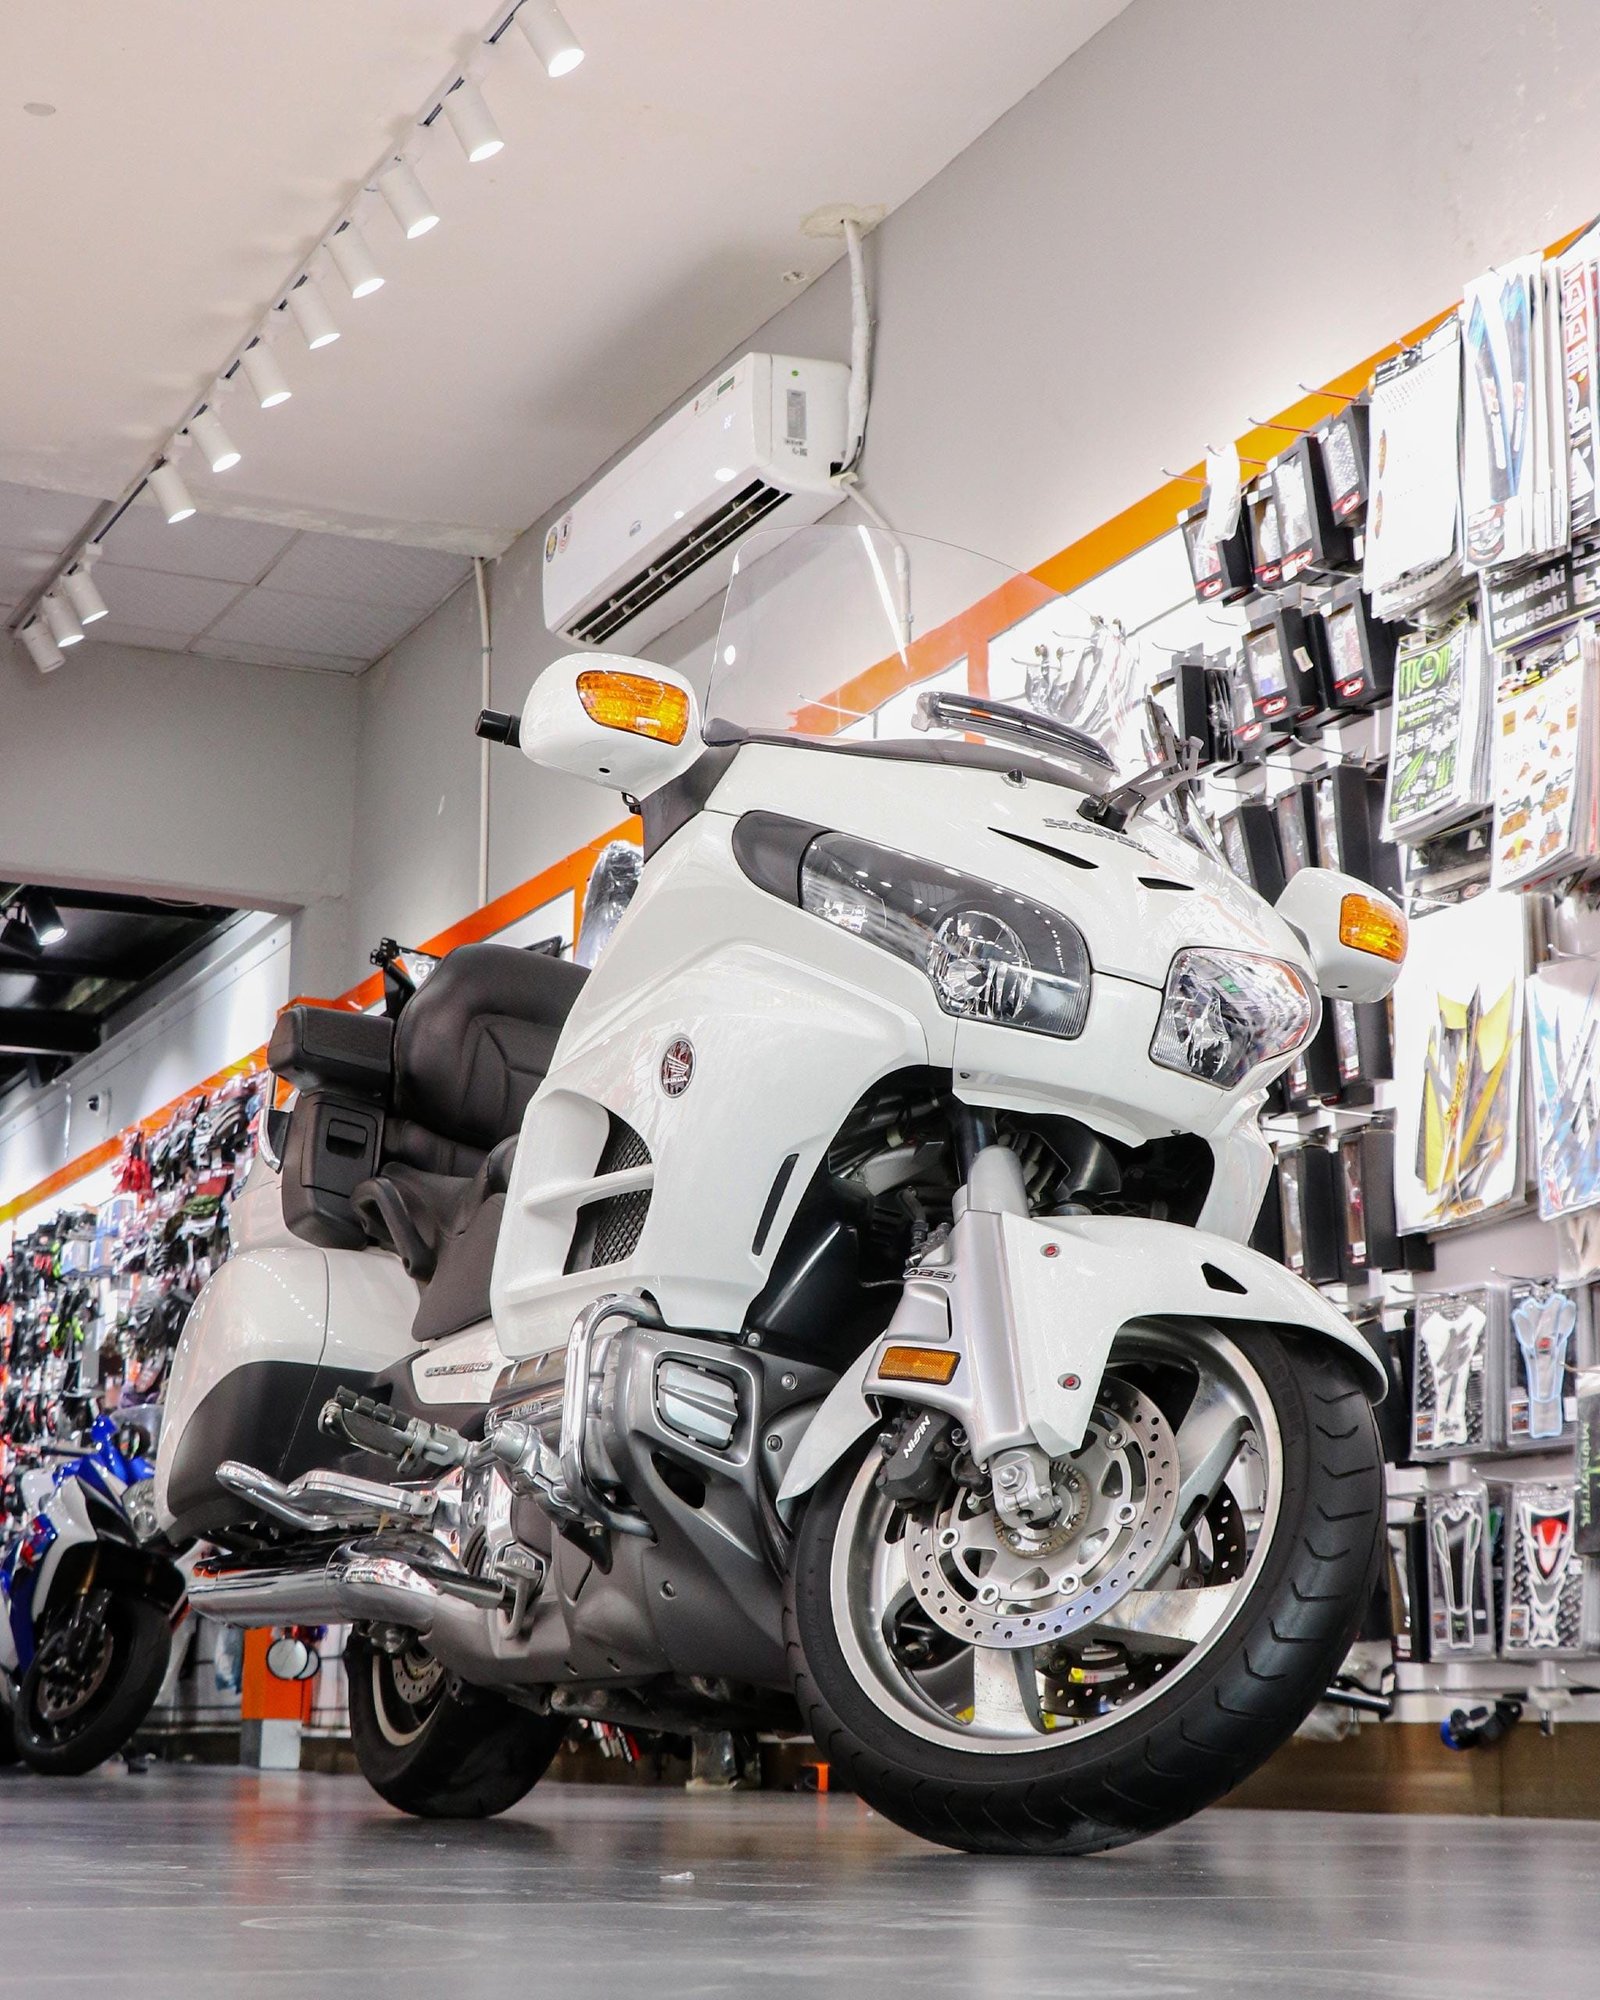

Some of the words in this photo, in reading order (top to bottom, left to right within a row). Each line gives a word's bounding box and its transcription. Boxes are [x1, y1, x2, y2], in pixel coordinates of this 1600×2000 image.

[1491, 564, 1566, 614] Kawasaki
[1493, 591, 1568, 640] Kawasaki
[1042, 817, 1159, 860] HONDA
[904, 1269, 951, 1280] ABS
